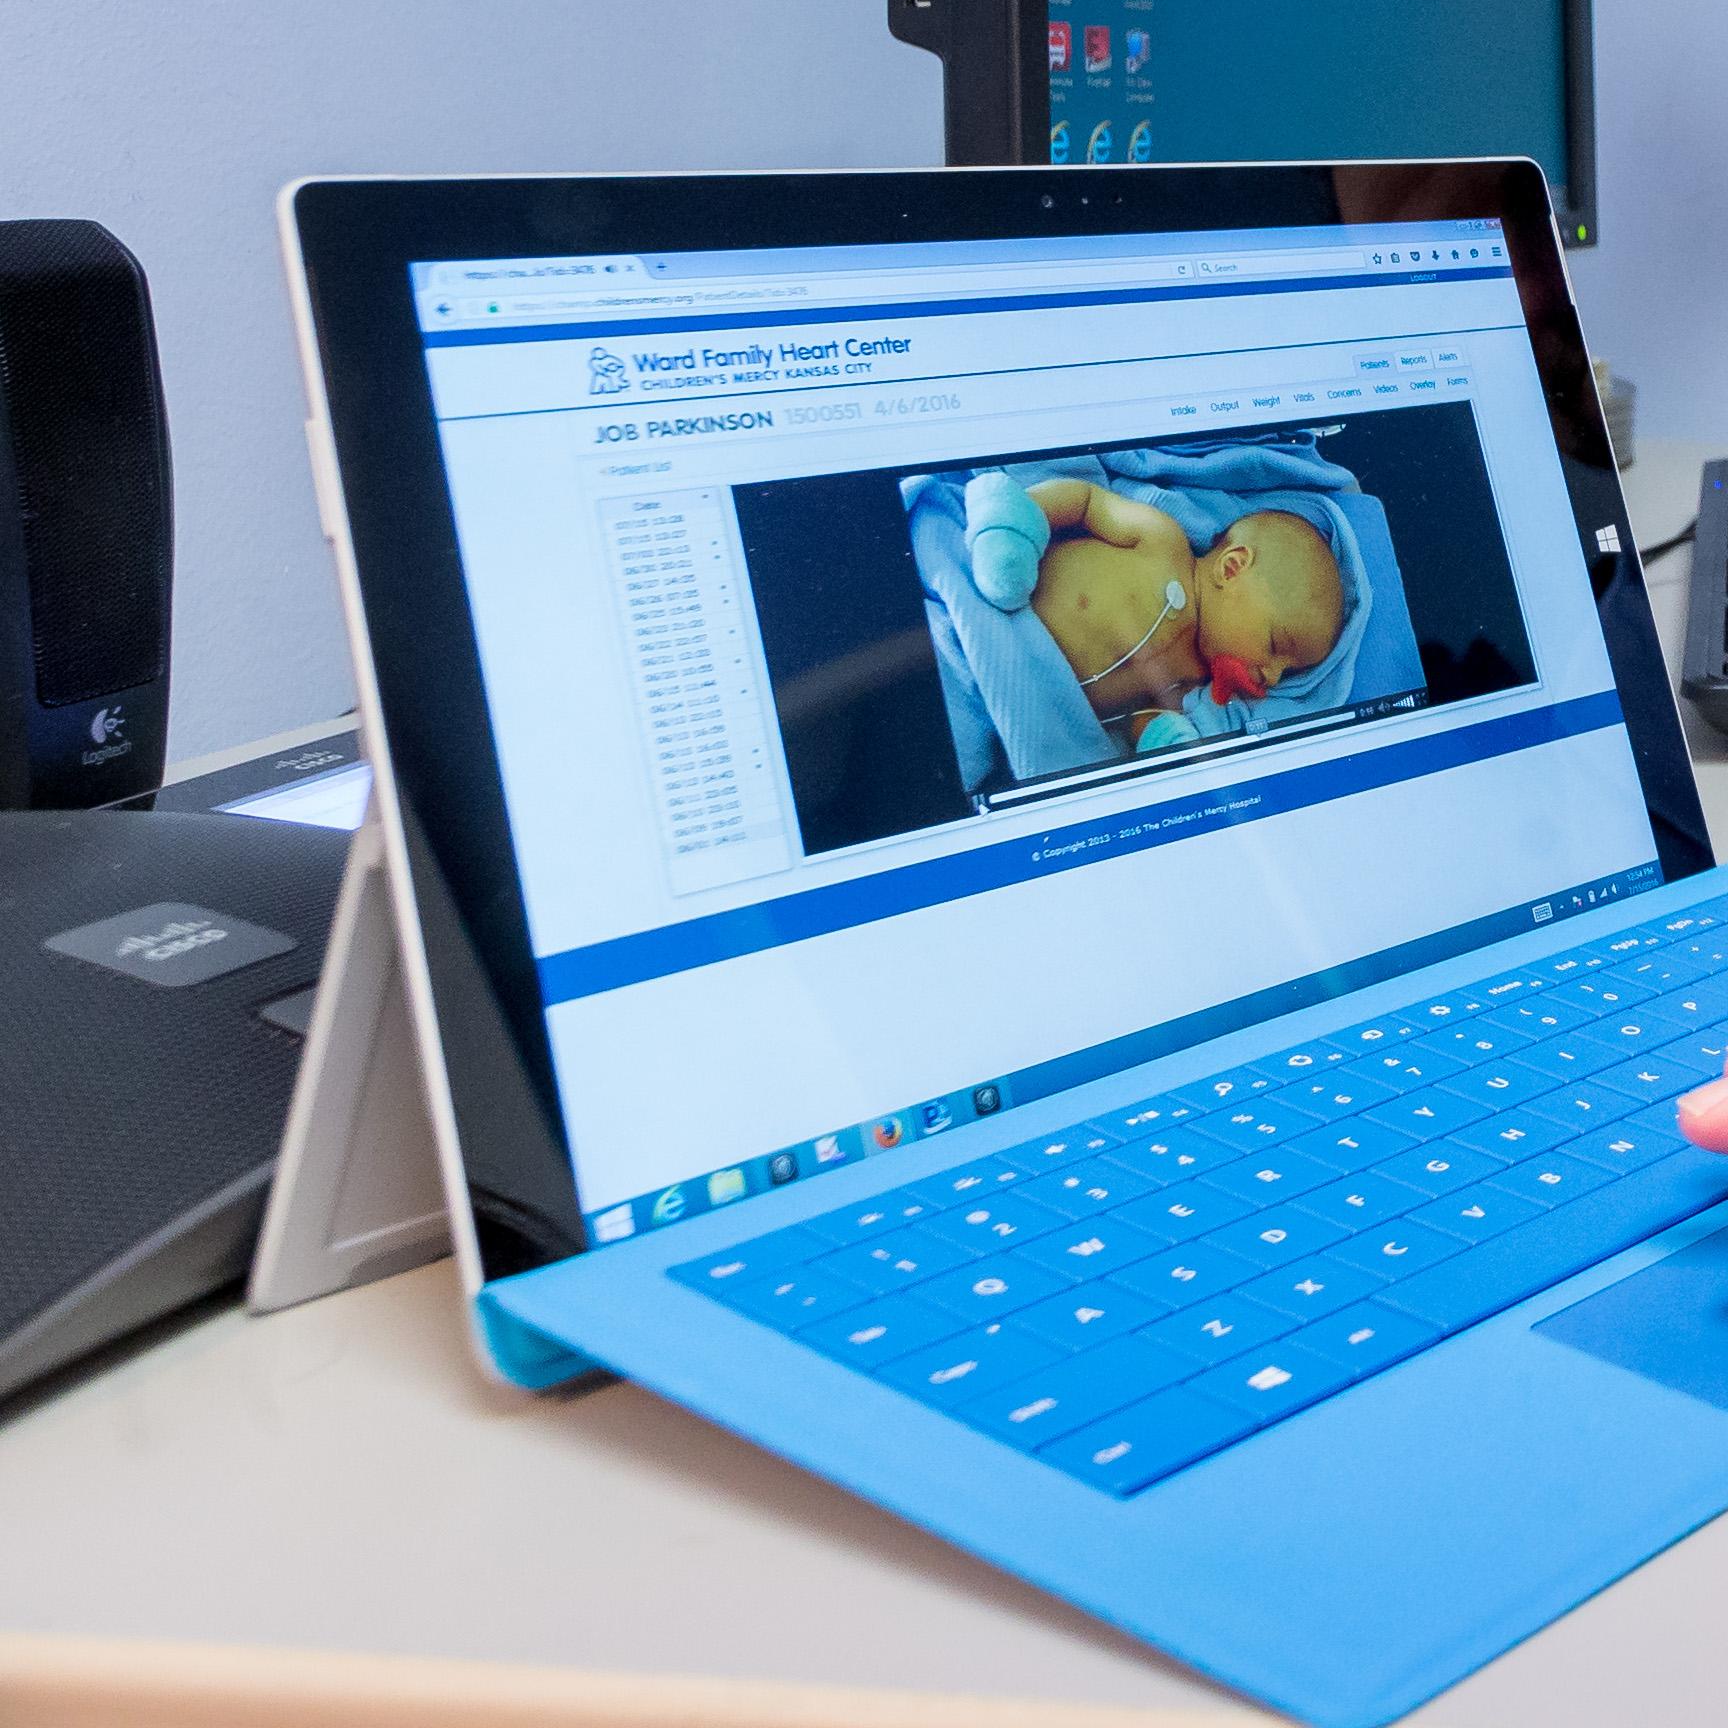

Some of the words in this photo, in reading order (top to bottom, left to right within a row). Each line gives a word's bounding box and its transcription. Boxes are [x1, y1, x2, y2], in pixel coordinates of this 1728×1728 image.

[632, 348, 696, 373] Ward
[702, 344, 773, 370] Family
[779, 340, 839, 362] Heart
[845, 337, 912, 358] Center
[1401, 356, 1427, 367] Reports
[1360, 360, 1390, 370] Patients
[640, 374, 726, 391] CHILDREN'S
[734, 369, 779, 385] MERCY
[785, 364, 839, 379] KANSAS
[845, 361, 873, 374] CITY
[1170, 405, 1197, 416] Intake
[1210, 401, 1239, 412] Output
[1252, 396, 1280, 409] Weight
[1293, 392, 1315, 403] Vitals
[1327, 388, 1362, 399] Concerns
[1373, 384, 1398, 394] Videos
[1410, 380, 1435, 390] Overlay
[1446, 377, 1468, 386] Forms
[594, 423, 639, 444] JOB
[647, 410, 775, 439] PARKINSON
[874, 393, 961, 416] 4/6/2016
[82, 740, 132, 765] Logitech
[1043, 840, 1086, 859] Copyright
[1143, 821, 1160, 832] The
[1162, 811, 1203, 827] Children's
[1204, 804, 1228, 817] Mercy
[1229, 795, 1262, 811] Hospital
[1555, 960, 1578, 971] End
[1488, 980, 1523, 995] Home
[1682, 1001, 1697, 1011] P
[1541, 1016, 1557, 1025] 9
[1620, 1025, 1641, 1035] O
[1475, 1040, 1493, 1051] 8
[1701, 1047, 1721, 1055] L
[1405, 1066, 1422, 1076] 7
[1637, 1071, 1660, 1082] K
[1486, 1077, 1509, 1089] U
[1334, 1094, 1353, 1104] 6
[1575, 1100, 1592, 1110] J
[1412, 1106, 1435, 1118] Y
[1256, 1123, 1276, 1135] 5
[1500, 1128, 1526, 1141] H
[1337, 1135, 1359, 1149] T
[1609, 1139, 1635, 1153] N
[1426, 1159, 1450, 1172] G
[1255, 1169, 1283, 1182] R
[1538, 1172, 1562, 1185] B
[1345, 1194, 1365, 1207] F
[1168, 1203, 1196, 1218] E
[1461, 1205, 1486, 1219] V
[992, 1222, 1018, 1237] 2
[1259, 1228, 1288, 1244] D
[1383, 1241, 1409, 1256] C
[1170, 1266, 1197, 1282] S
[1293, 1278, 1325, 1296] X
[1201, 1319, 1234, 1338] Z
